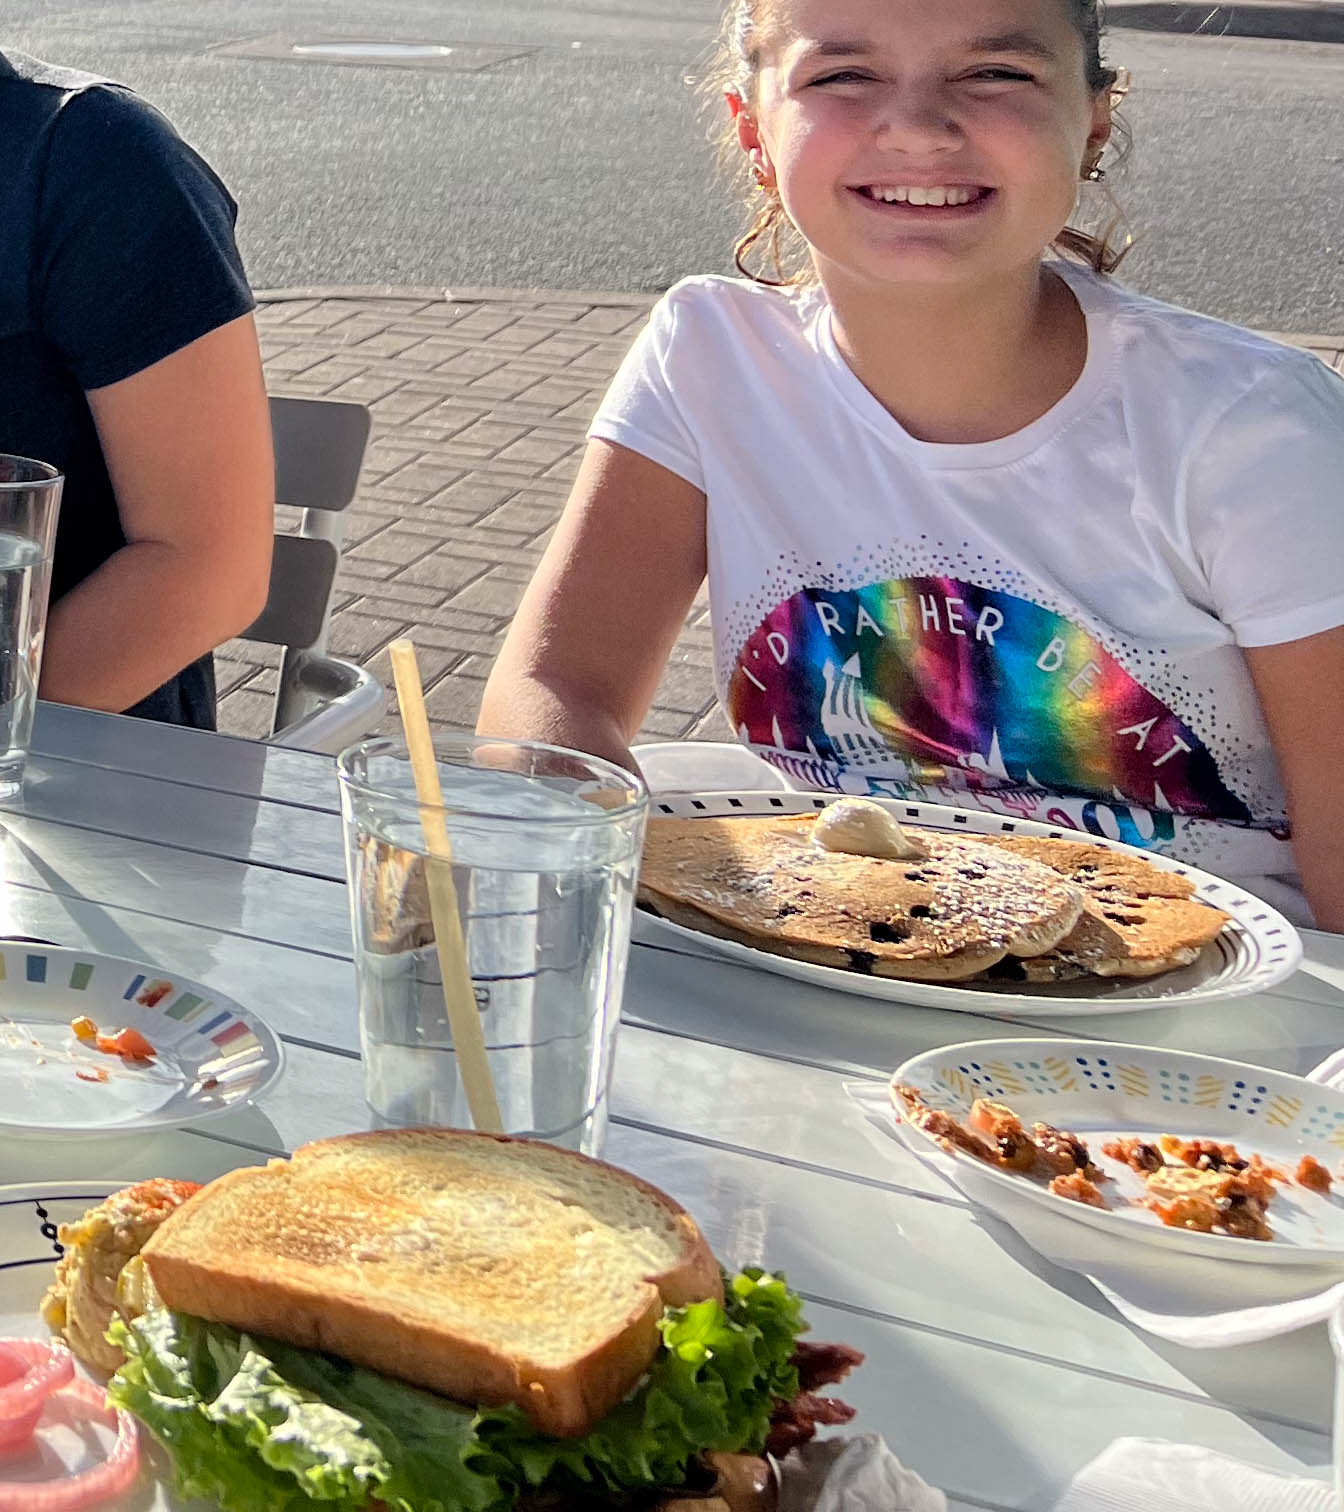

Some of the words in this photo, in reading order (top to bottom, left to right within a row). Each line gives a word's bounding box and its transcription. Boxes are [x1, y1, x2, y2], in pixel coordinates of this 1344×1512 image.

[741, 631, 790, 691] I'D
[815, 596, 1005, 646] RATHER
[1035, 637, 1102, 702] BE
